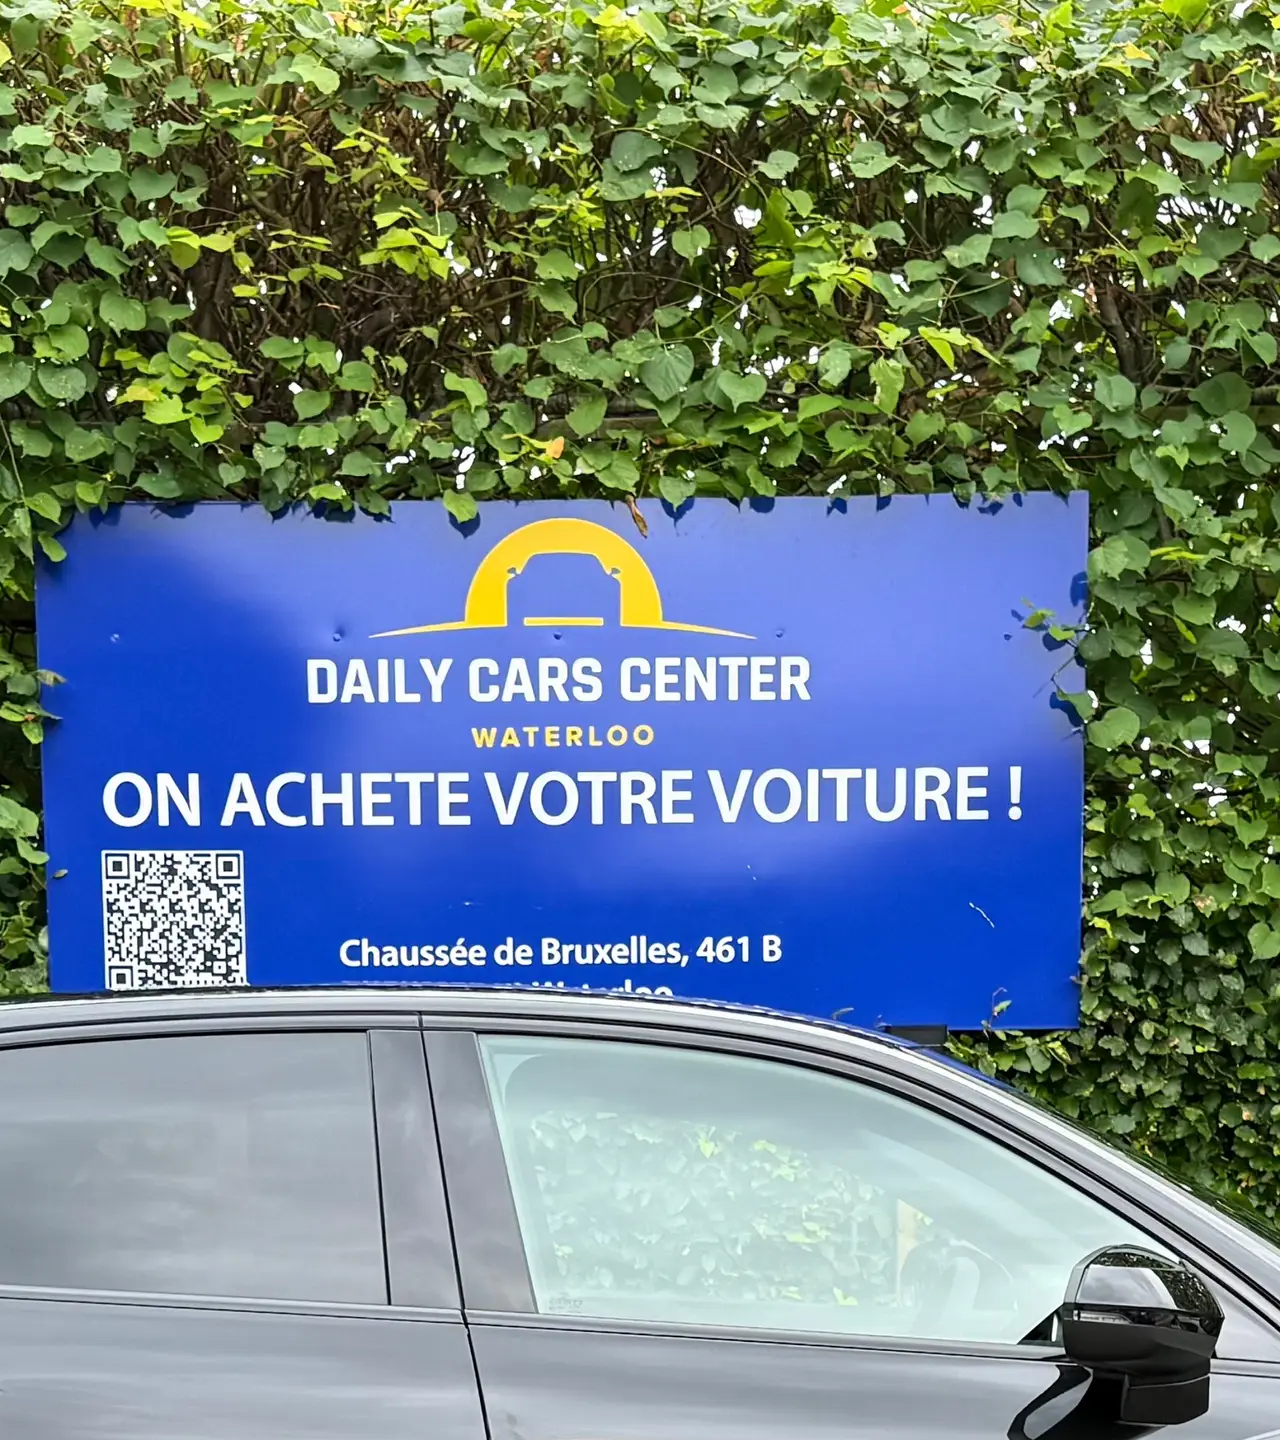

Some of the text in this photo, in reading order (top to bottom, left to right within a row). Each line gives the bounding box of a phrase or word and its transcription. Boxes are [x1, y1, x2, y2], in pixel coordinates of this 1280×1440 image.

[307, 656, 811, 703] DAILY CARS CENTER
[471, 724, 655, 748] WATERLOO
[103, 766, 1022, 827] ON ACHETE VOTRE VOITURE !
[339, 934, 782, 967] Chaussée de Bruxelles, 461 B
